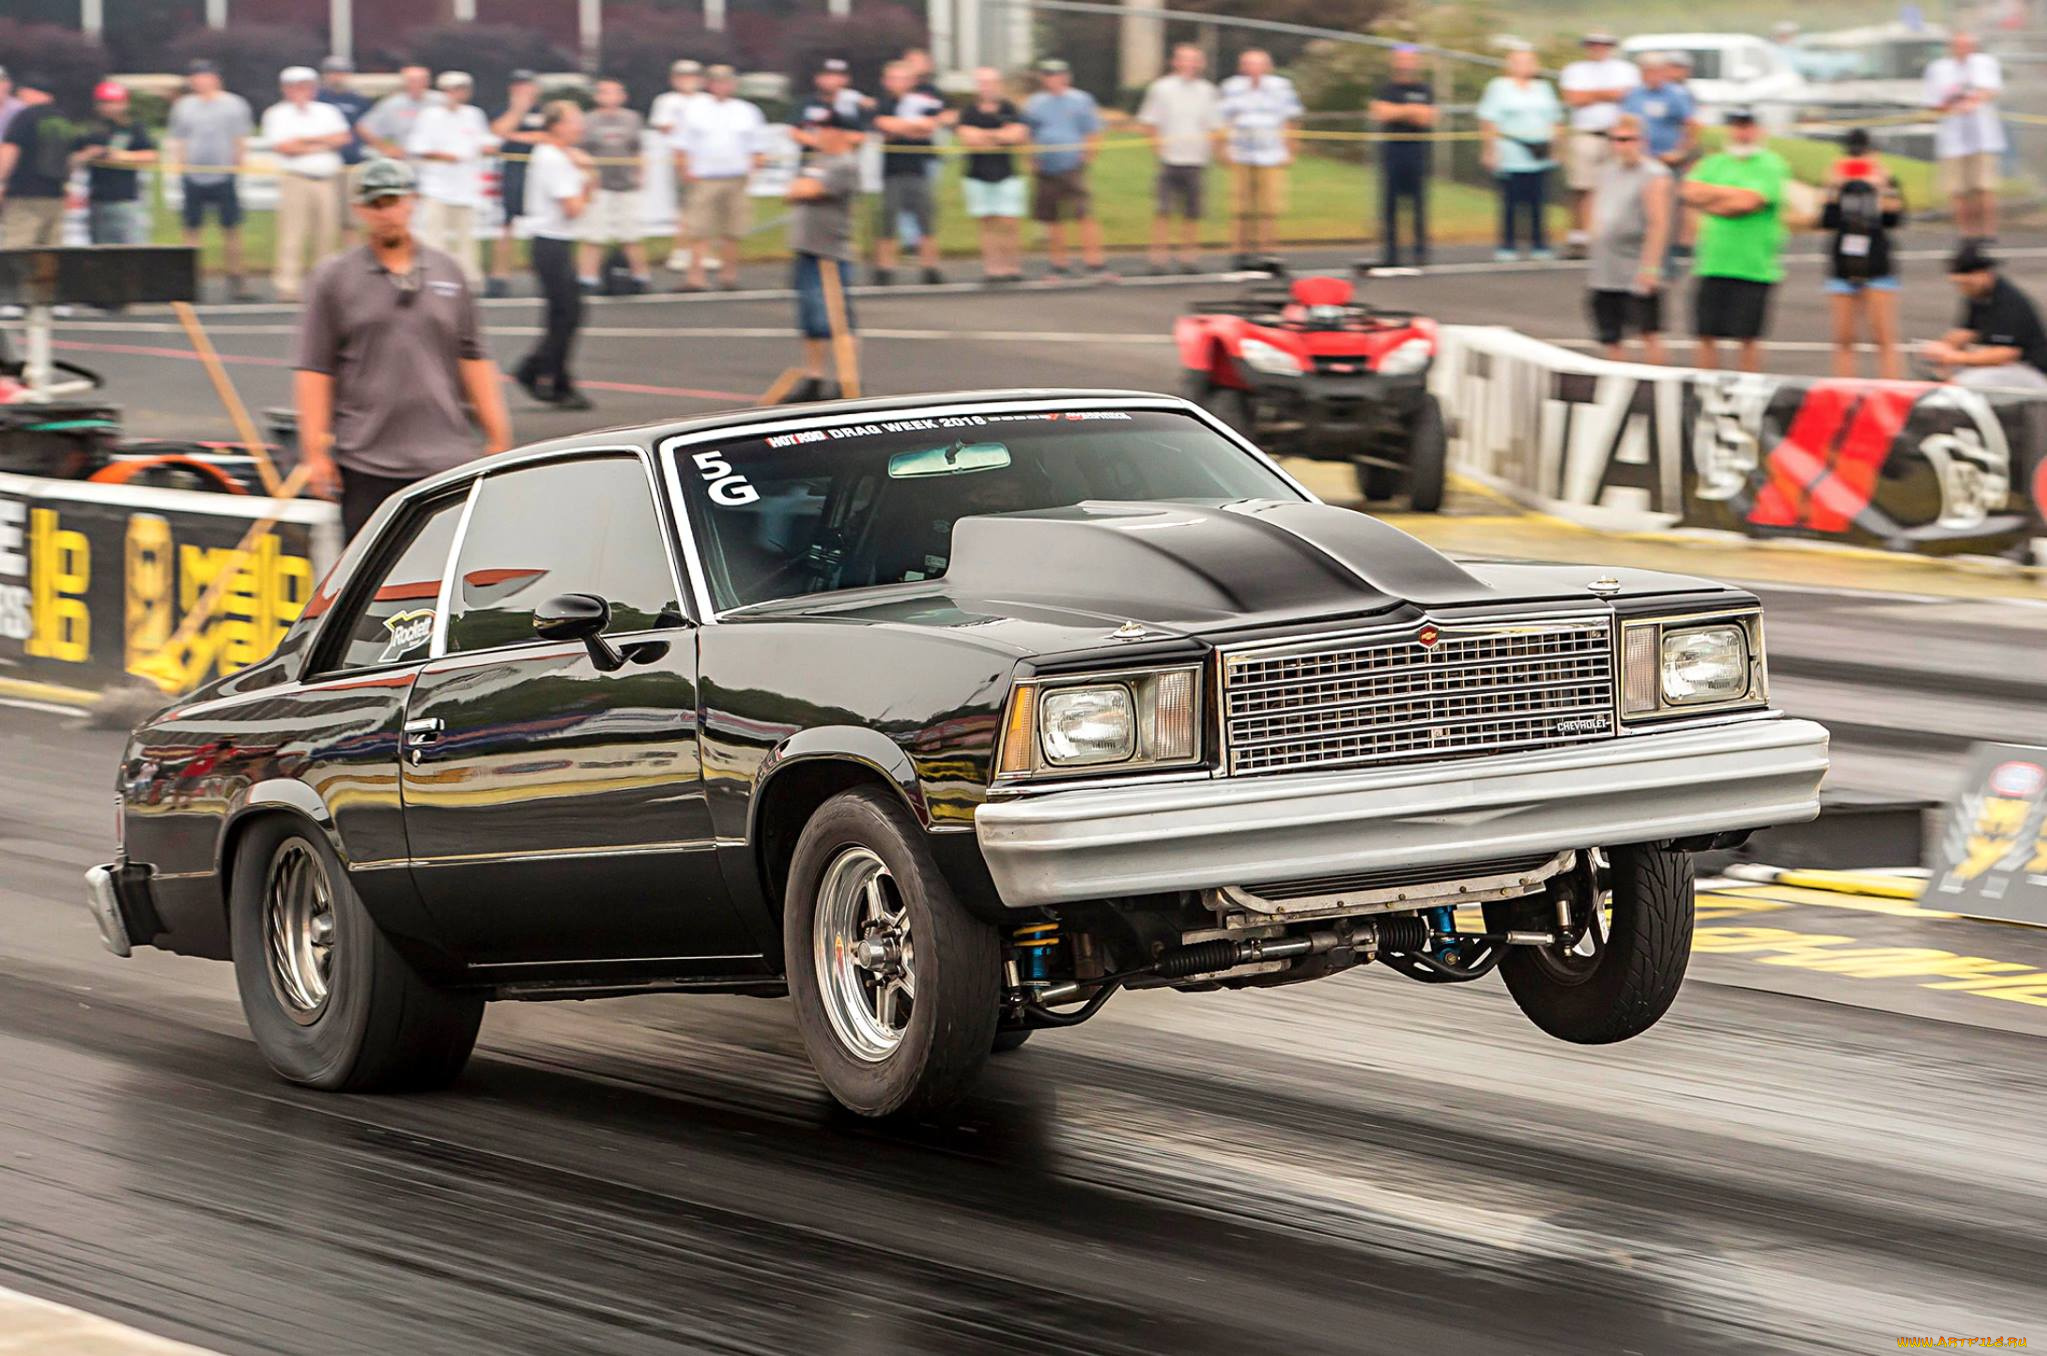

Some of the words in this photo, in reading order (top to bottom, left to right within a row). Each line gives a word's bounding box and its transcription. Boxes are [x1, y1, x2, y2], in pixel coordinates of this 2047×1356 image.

[766, 434, 798, 449] HOT
[797, 430, 826, 444] ROD
[827, 424, 883, 440] DRAG
[881, 418, 938, 433] WEEK
[691, 450, 732, 481] 5
[707, 475, 761, 506] G
[1557, 719, 1606, 732] CHEVROLET
